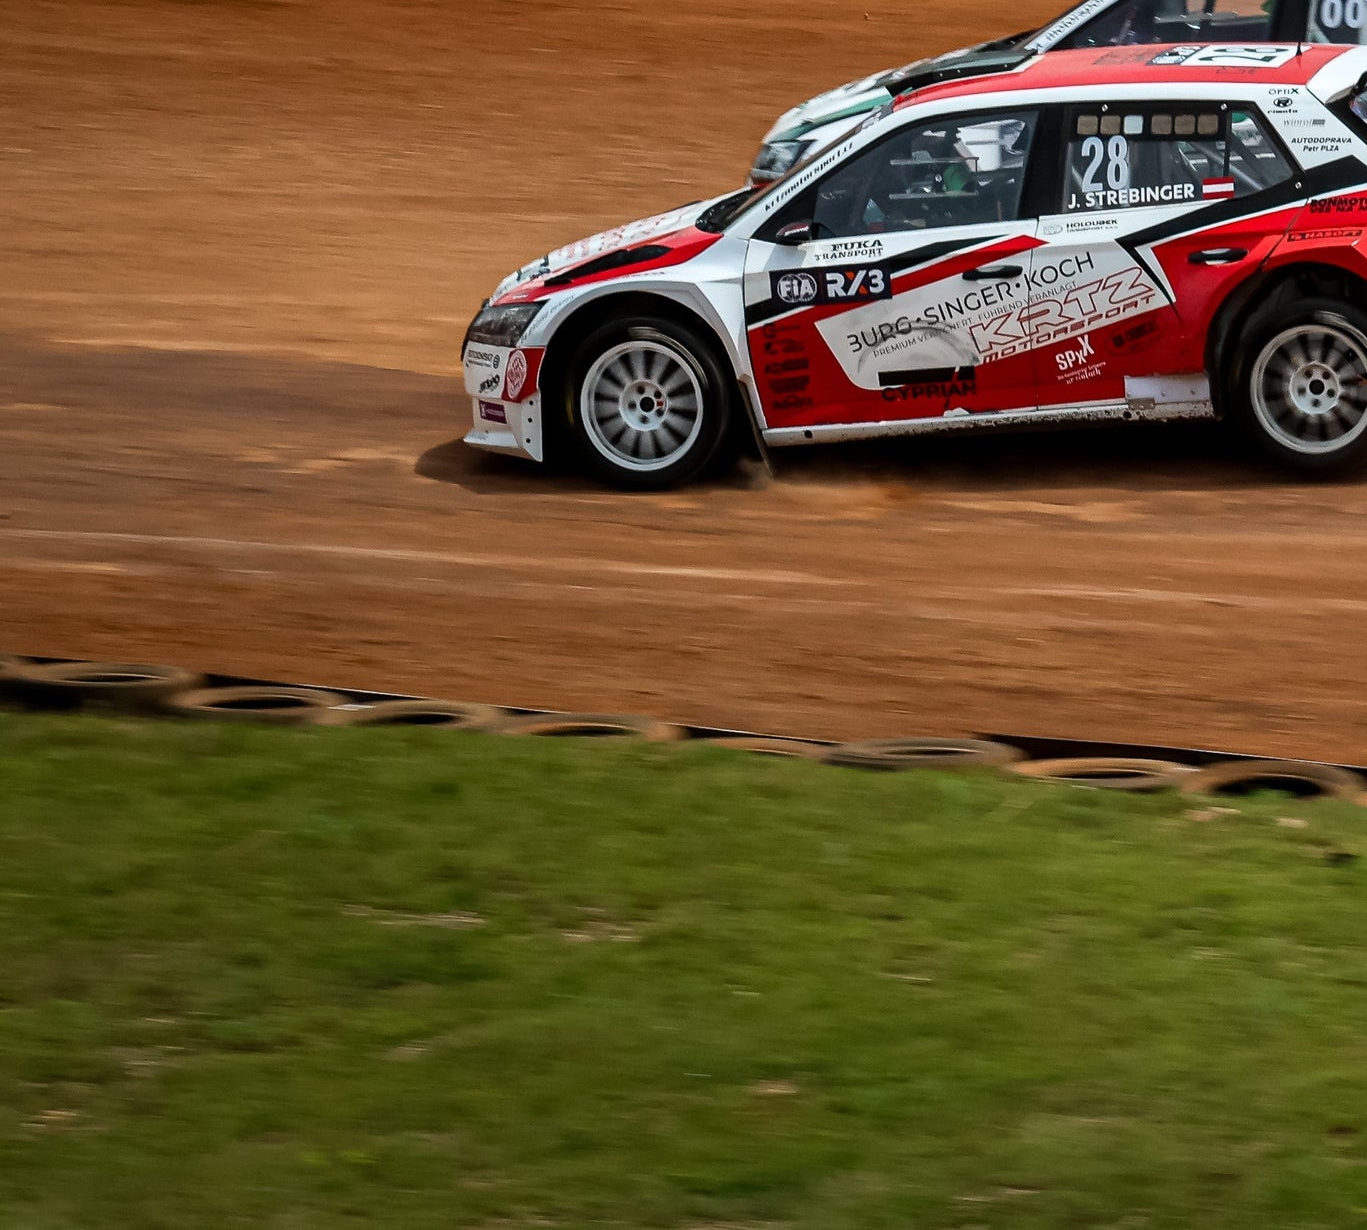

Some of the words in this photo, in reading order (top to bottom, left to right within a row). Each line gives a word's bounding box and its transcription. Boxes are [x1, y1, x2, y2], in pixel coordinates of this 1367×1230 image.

[1291, 136, 1352, 144] AUTODOPRAVA
[1081, 135, 1130, 192] 28
[1068, 193, 1081, 210] J.
[1085, 183, 1195, 208] STREBINGER
[814, 248, 884, 262] TRANSPORT
[832, 239, 883, 252] FUKA
[778, 276, 816, 300] FIA
[825, 268, 885, 298] RX3
[969, 266, 1154, 354] KRTZ
[981, 293, 1156, 364] MOTORSPORT
[881, 380, 977, 402] CYPRIAN
